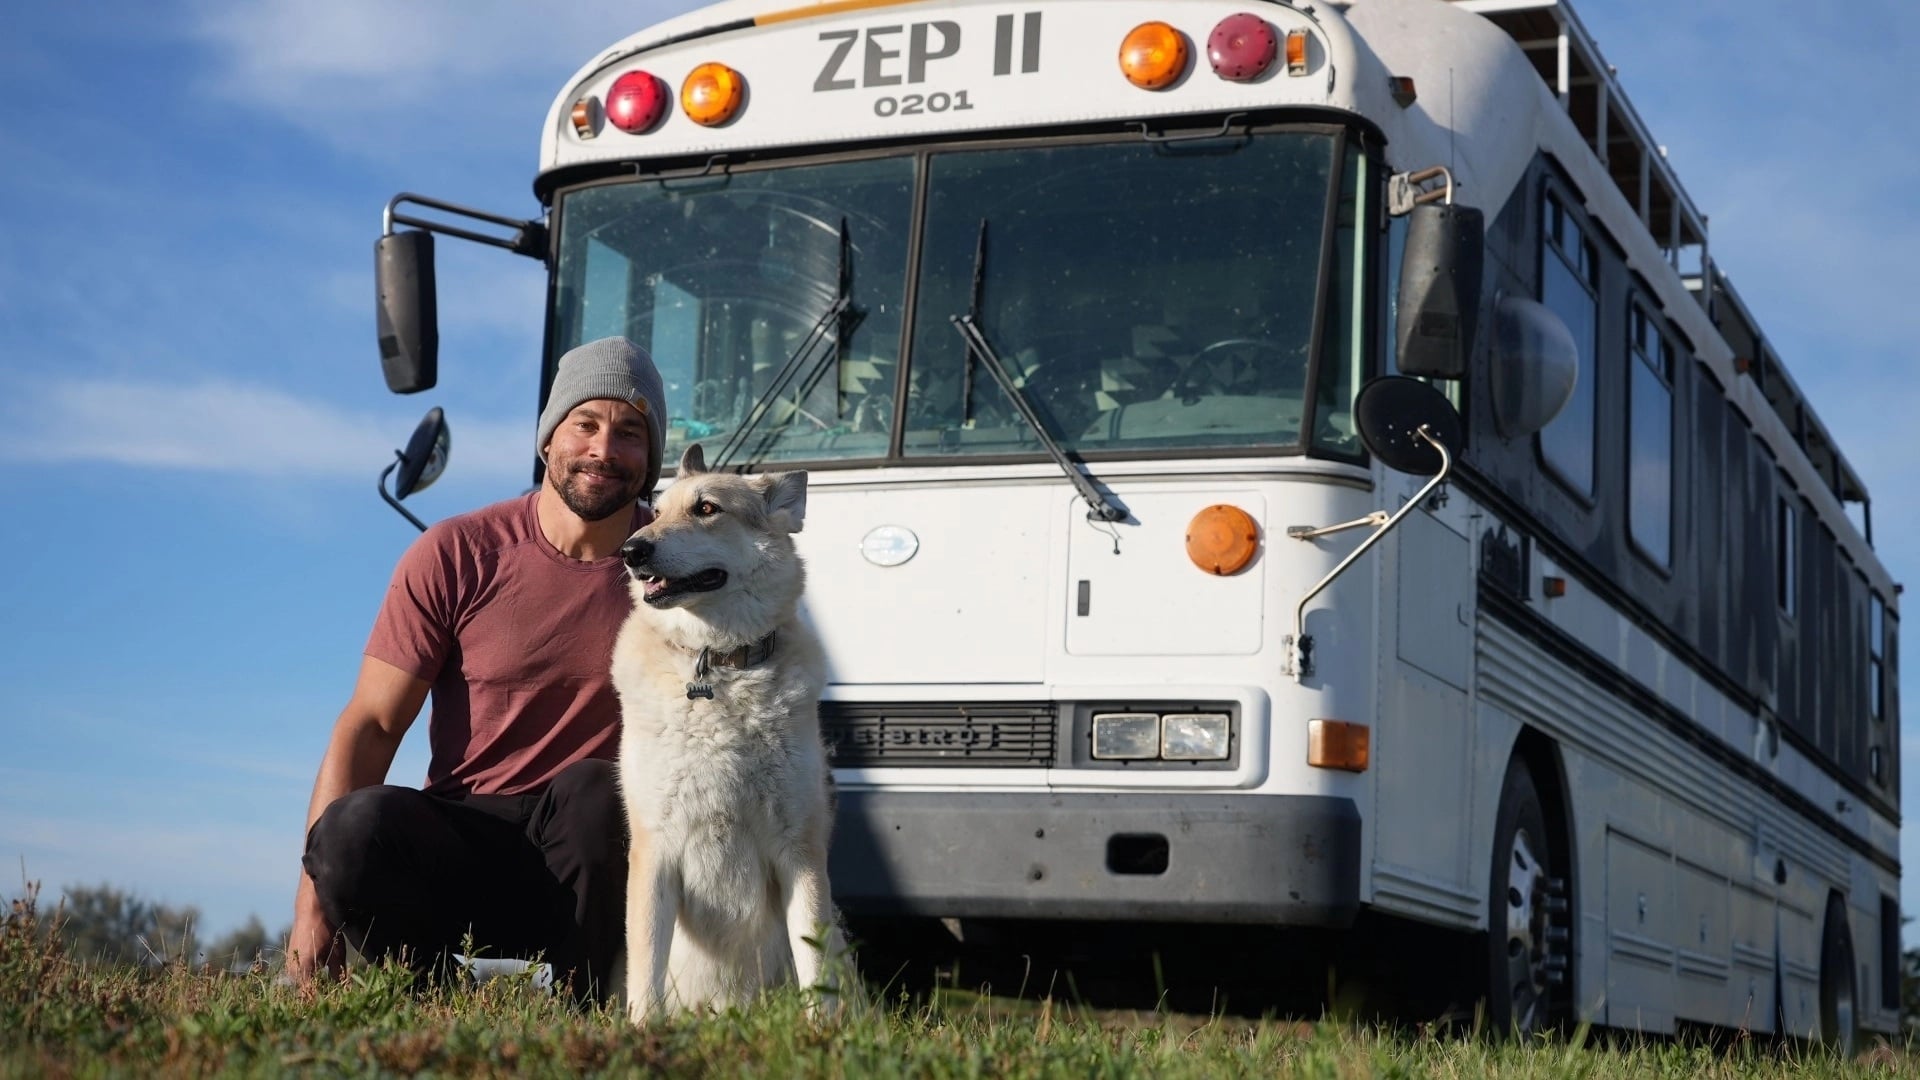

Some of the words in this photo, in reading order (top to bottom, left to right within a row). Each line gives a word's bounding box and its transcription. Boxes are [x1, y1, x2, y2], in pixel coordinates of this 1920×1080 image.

[813, 20, 961, 92] ZEP
[993, 11, 1042, 76] II
[873, 90, 974, 117] 0201
